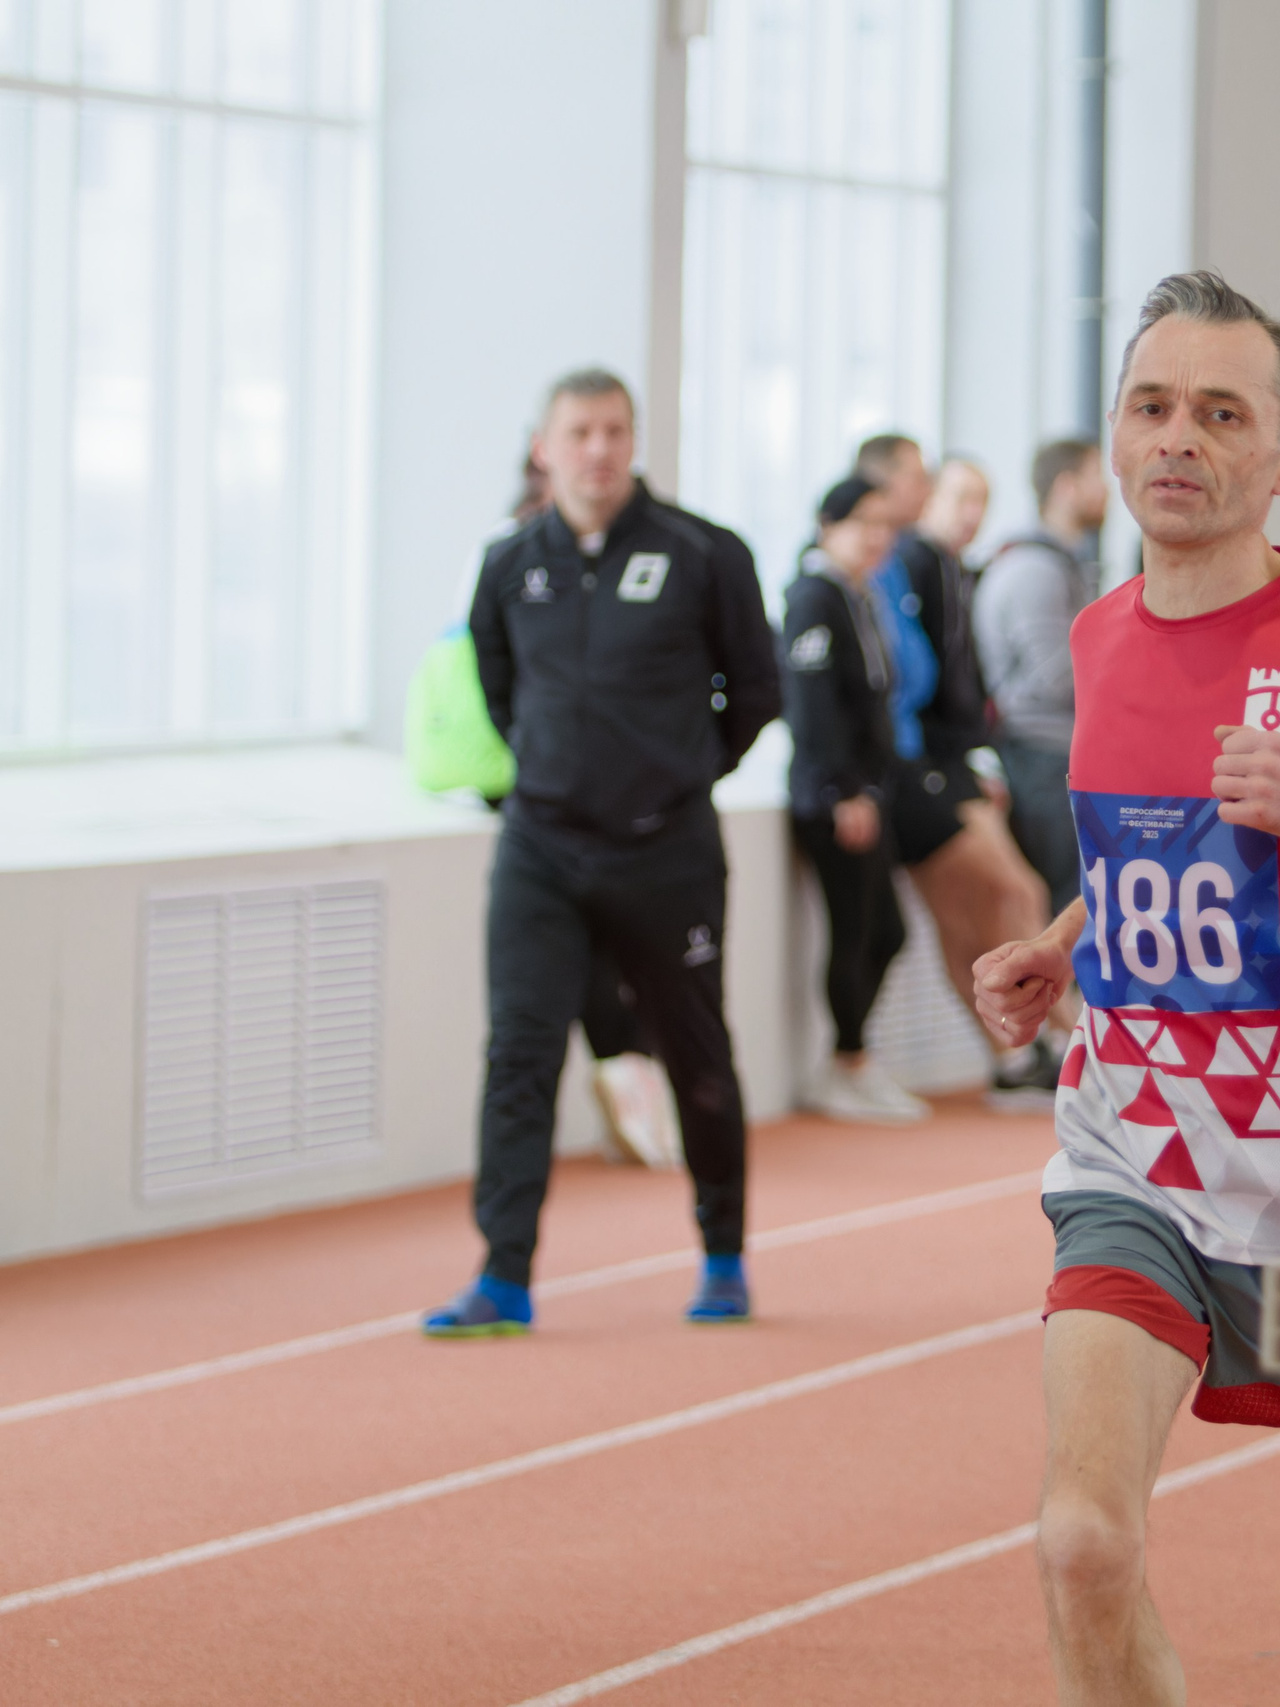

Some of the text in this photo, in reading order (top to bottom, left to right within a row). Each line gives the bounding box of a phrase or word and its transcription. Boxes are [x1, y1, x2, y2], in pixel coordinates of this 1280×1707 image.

[1119, 807, 1184, 817] ВСЕРОССИЙСКИЙ
[1128, 819, 1175, 829] ФЕСТИВАЛЬ
[1142, 829, 1159, 839] 2025
[1087, 856, 1243, 986] 186
